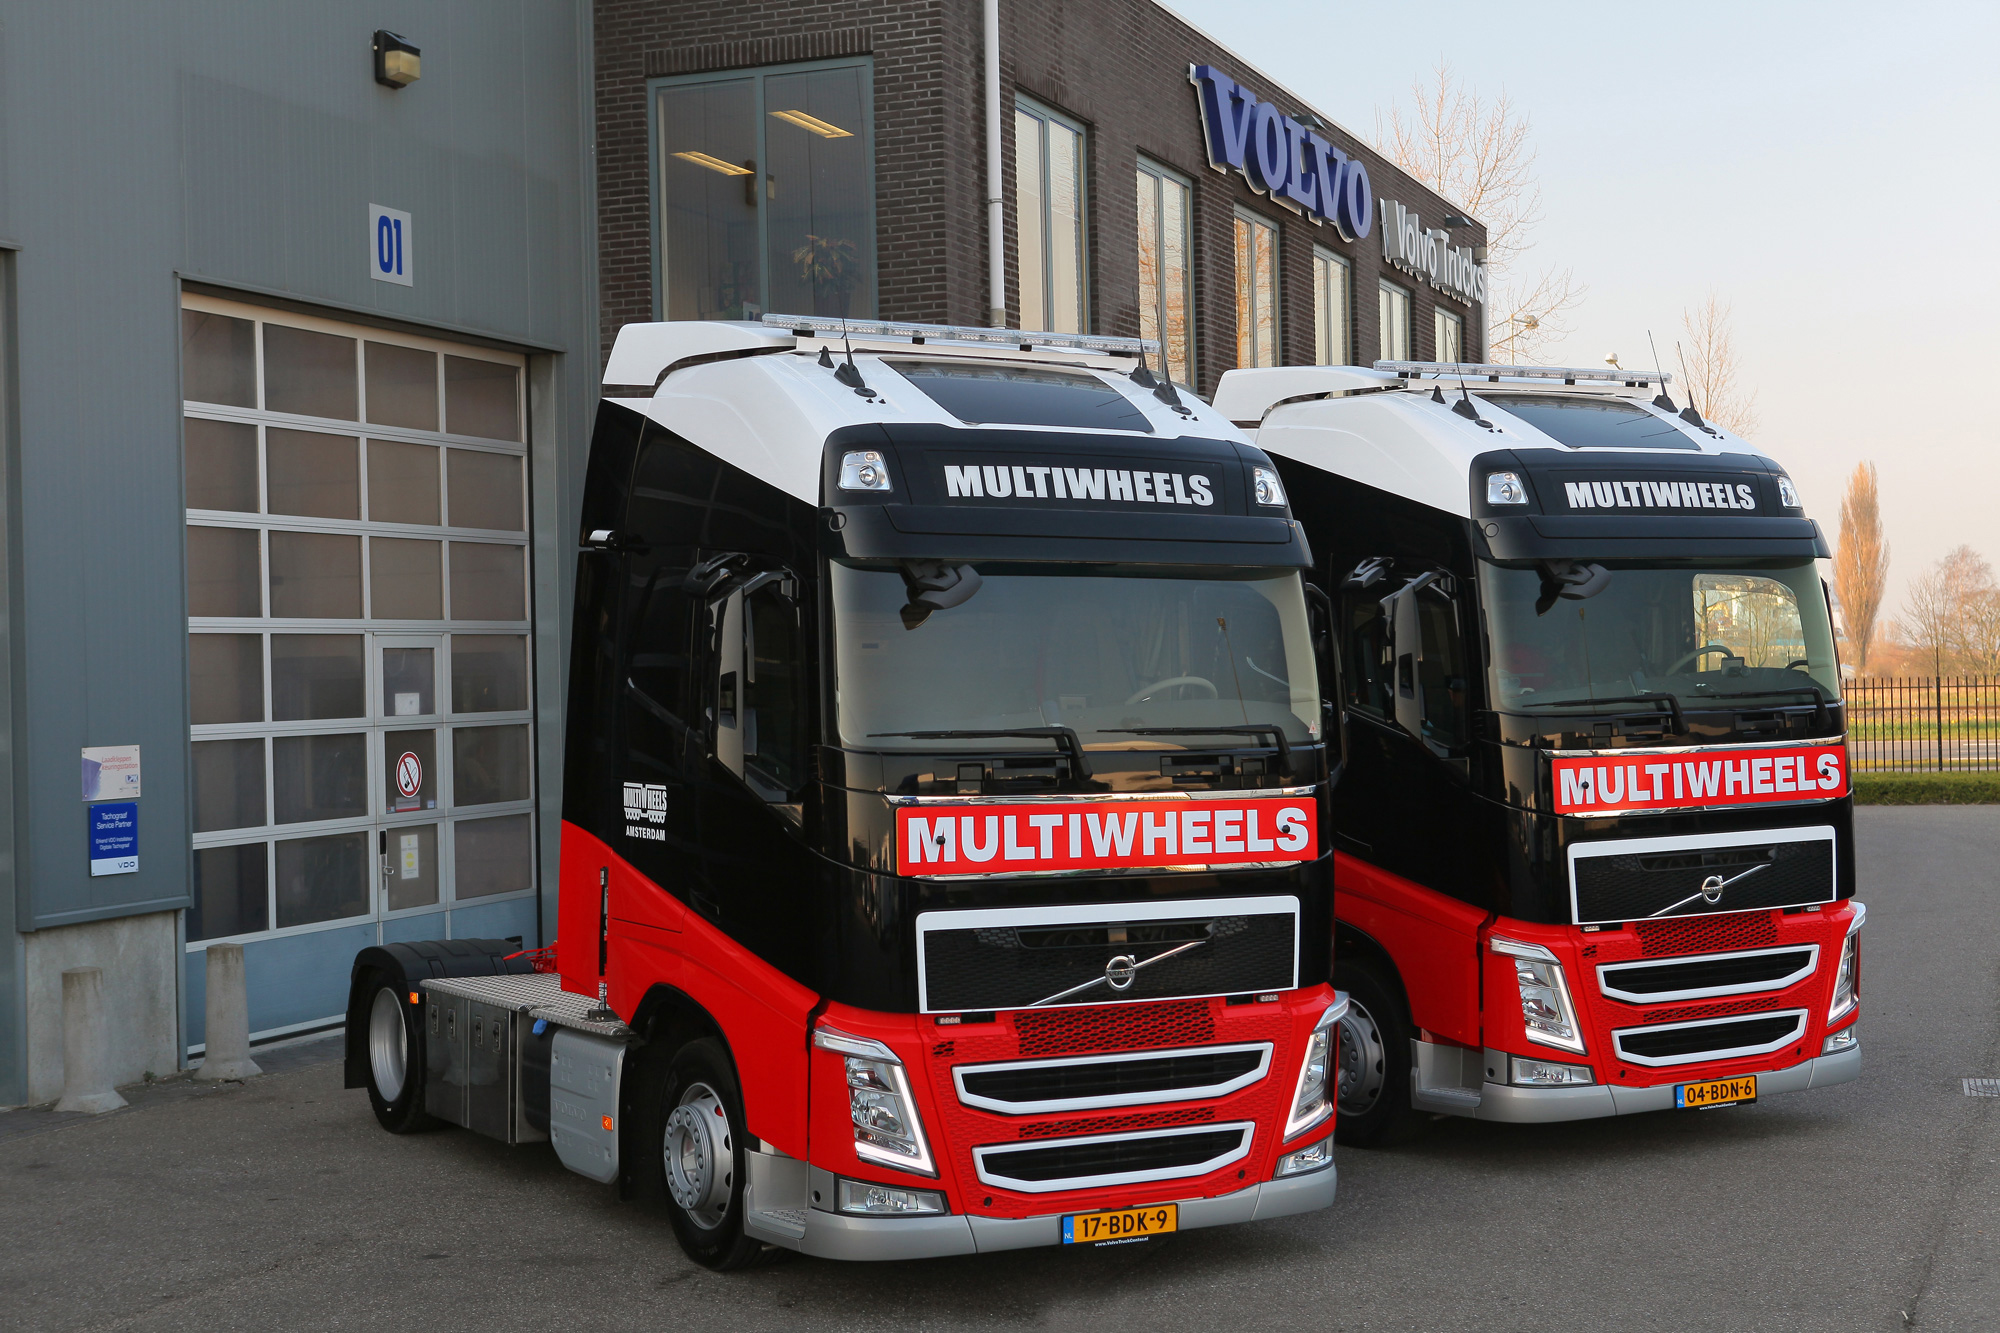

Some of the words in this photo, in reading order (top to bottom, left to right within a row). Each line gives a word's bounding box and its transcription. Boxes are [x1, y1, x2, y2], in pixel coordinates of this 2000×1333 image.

[1190, 62, 1373, 242] VOLVO
[377, 215, 402, 275] 01
[1382, 199, 1437, 281] Volvo
[1436, 228, 1486, 306] Trucks
[943, 465, 1214, 507] MULTIWHEELS
[1564, 481, 1756, 511] MULTIWHEELS
[1560, 753, 1841, 806] MULTIWHEELS
[624, 787, 667, 811] MULTIWHEELS
[96, 822, 115, 830] Service
[115, 820, 133, 828] Partner
[101, 812, 128, 820] Tachograaf
[626, 825, 665, 841] AMSTERDAM
[907, 807, 1309, 864] MULTIWHEELS
[1687, 1080, 1752, 1103] 04-BDN-6
[1082, 1209, 1168, 1238] 17-BDK-9
